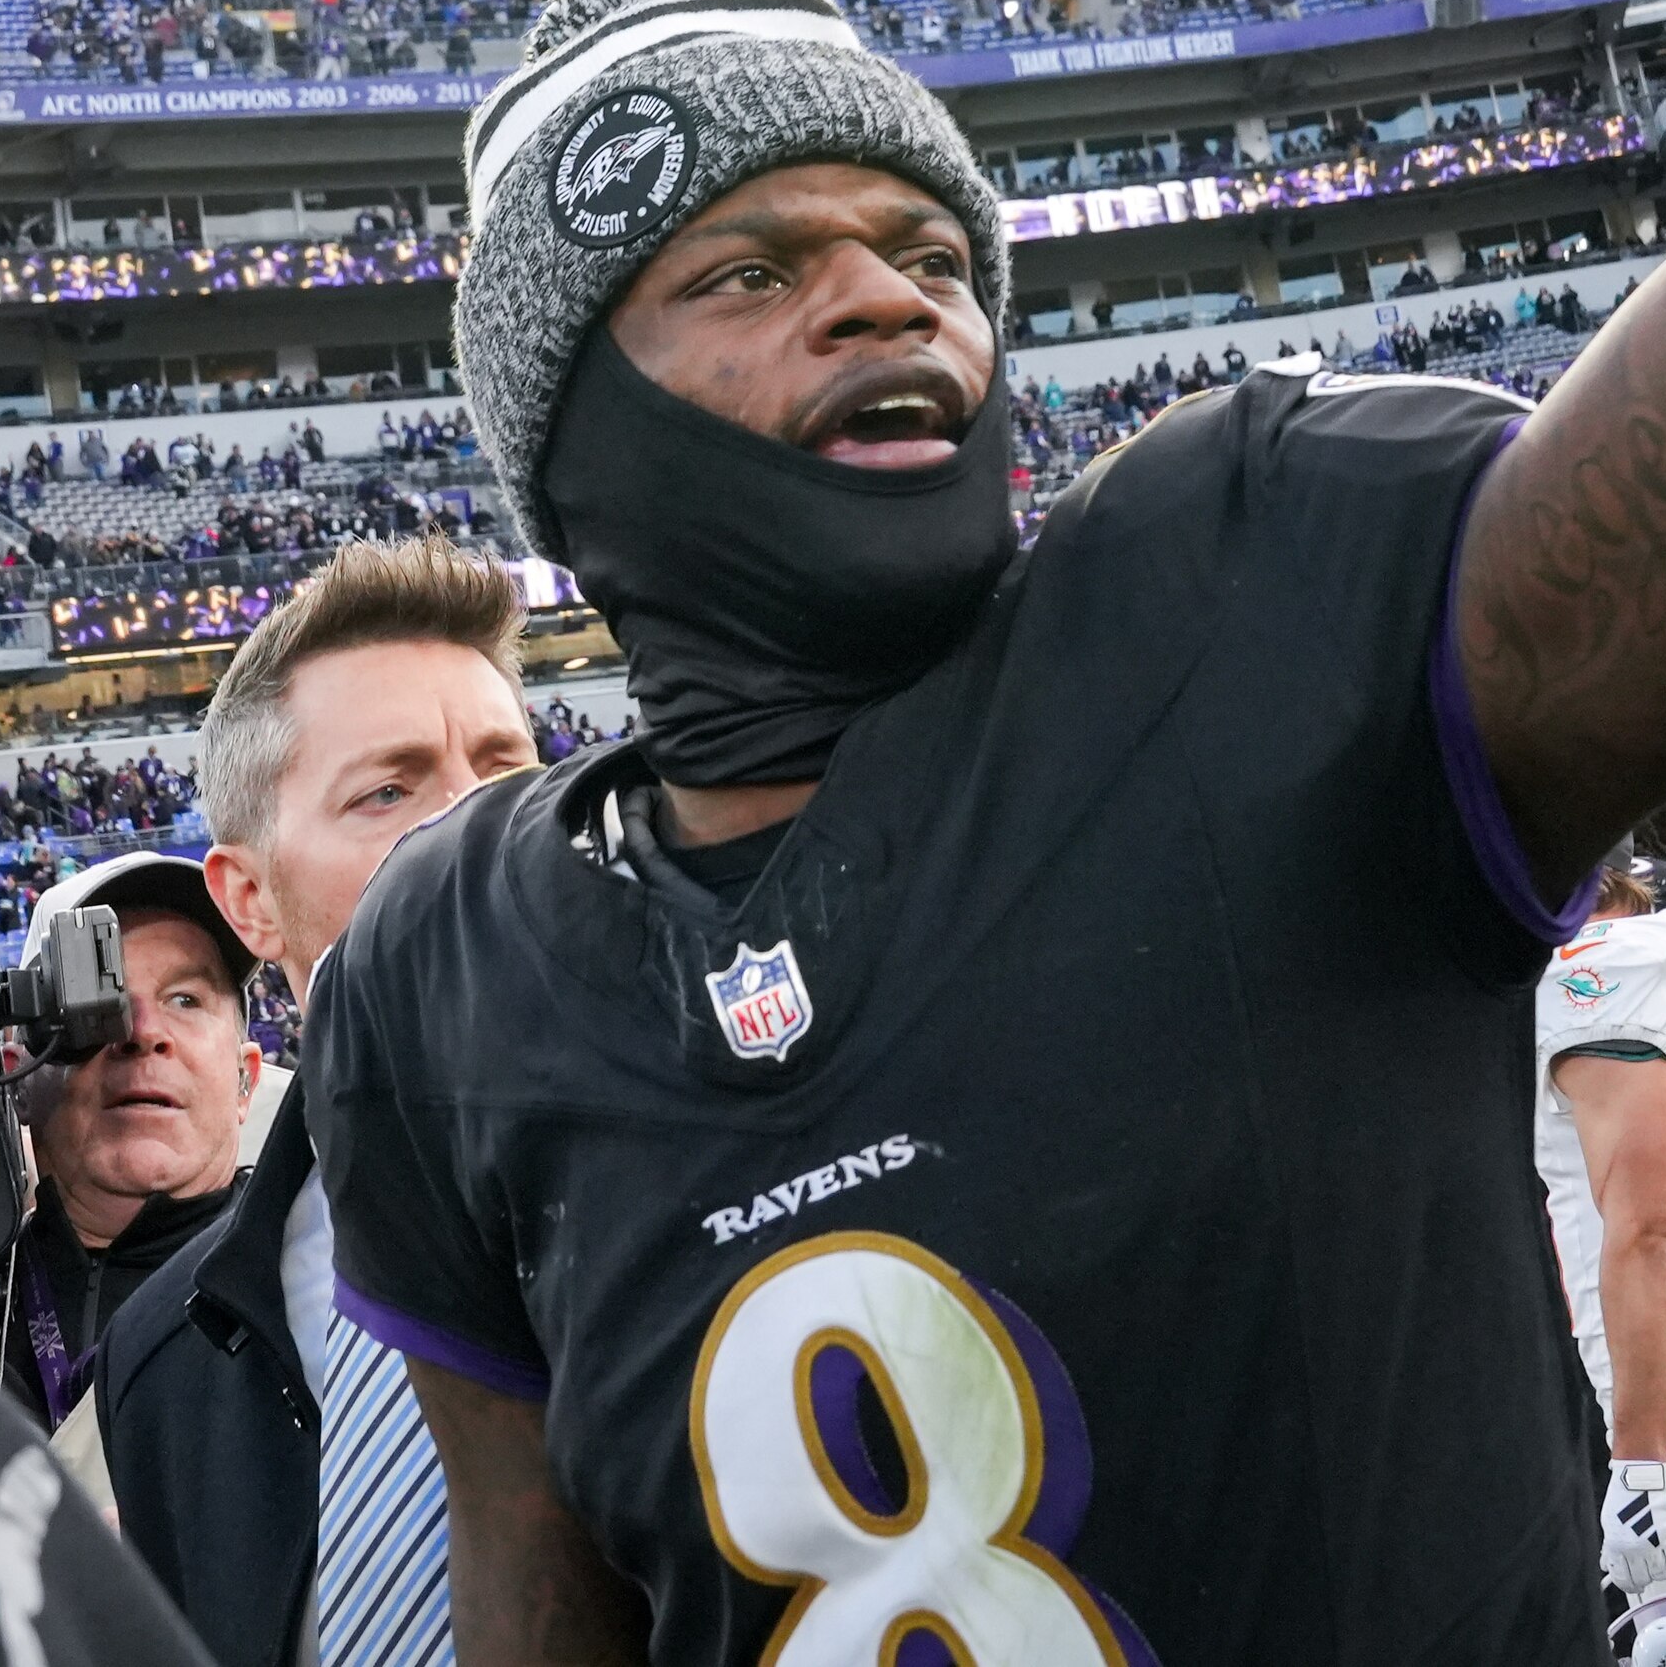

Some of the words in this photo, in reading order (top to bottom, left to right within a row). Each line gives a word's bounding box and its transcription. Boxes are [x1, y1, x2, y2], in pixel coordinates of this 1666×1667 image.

[40, 94, 83, 116] AFC
[86, 91, 163, 115] NORTH
[165, 86, 293, 113] CHAMPIONS
[366, 83, 420, 106] 2006
[627, 94, 674, 124] EQUITY
[555, 107, 605, 206] OPPORTUNITY
[647, 132, 686, 207] FREEDOM
[569, 208, 629, 237] JUSTICE
[734, 989, 797, 1042] NFL
[701, 1133, 917, 1246] RAVENS
[689, 1230, 1133, 1667] 8
